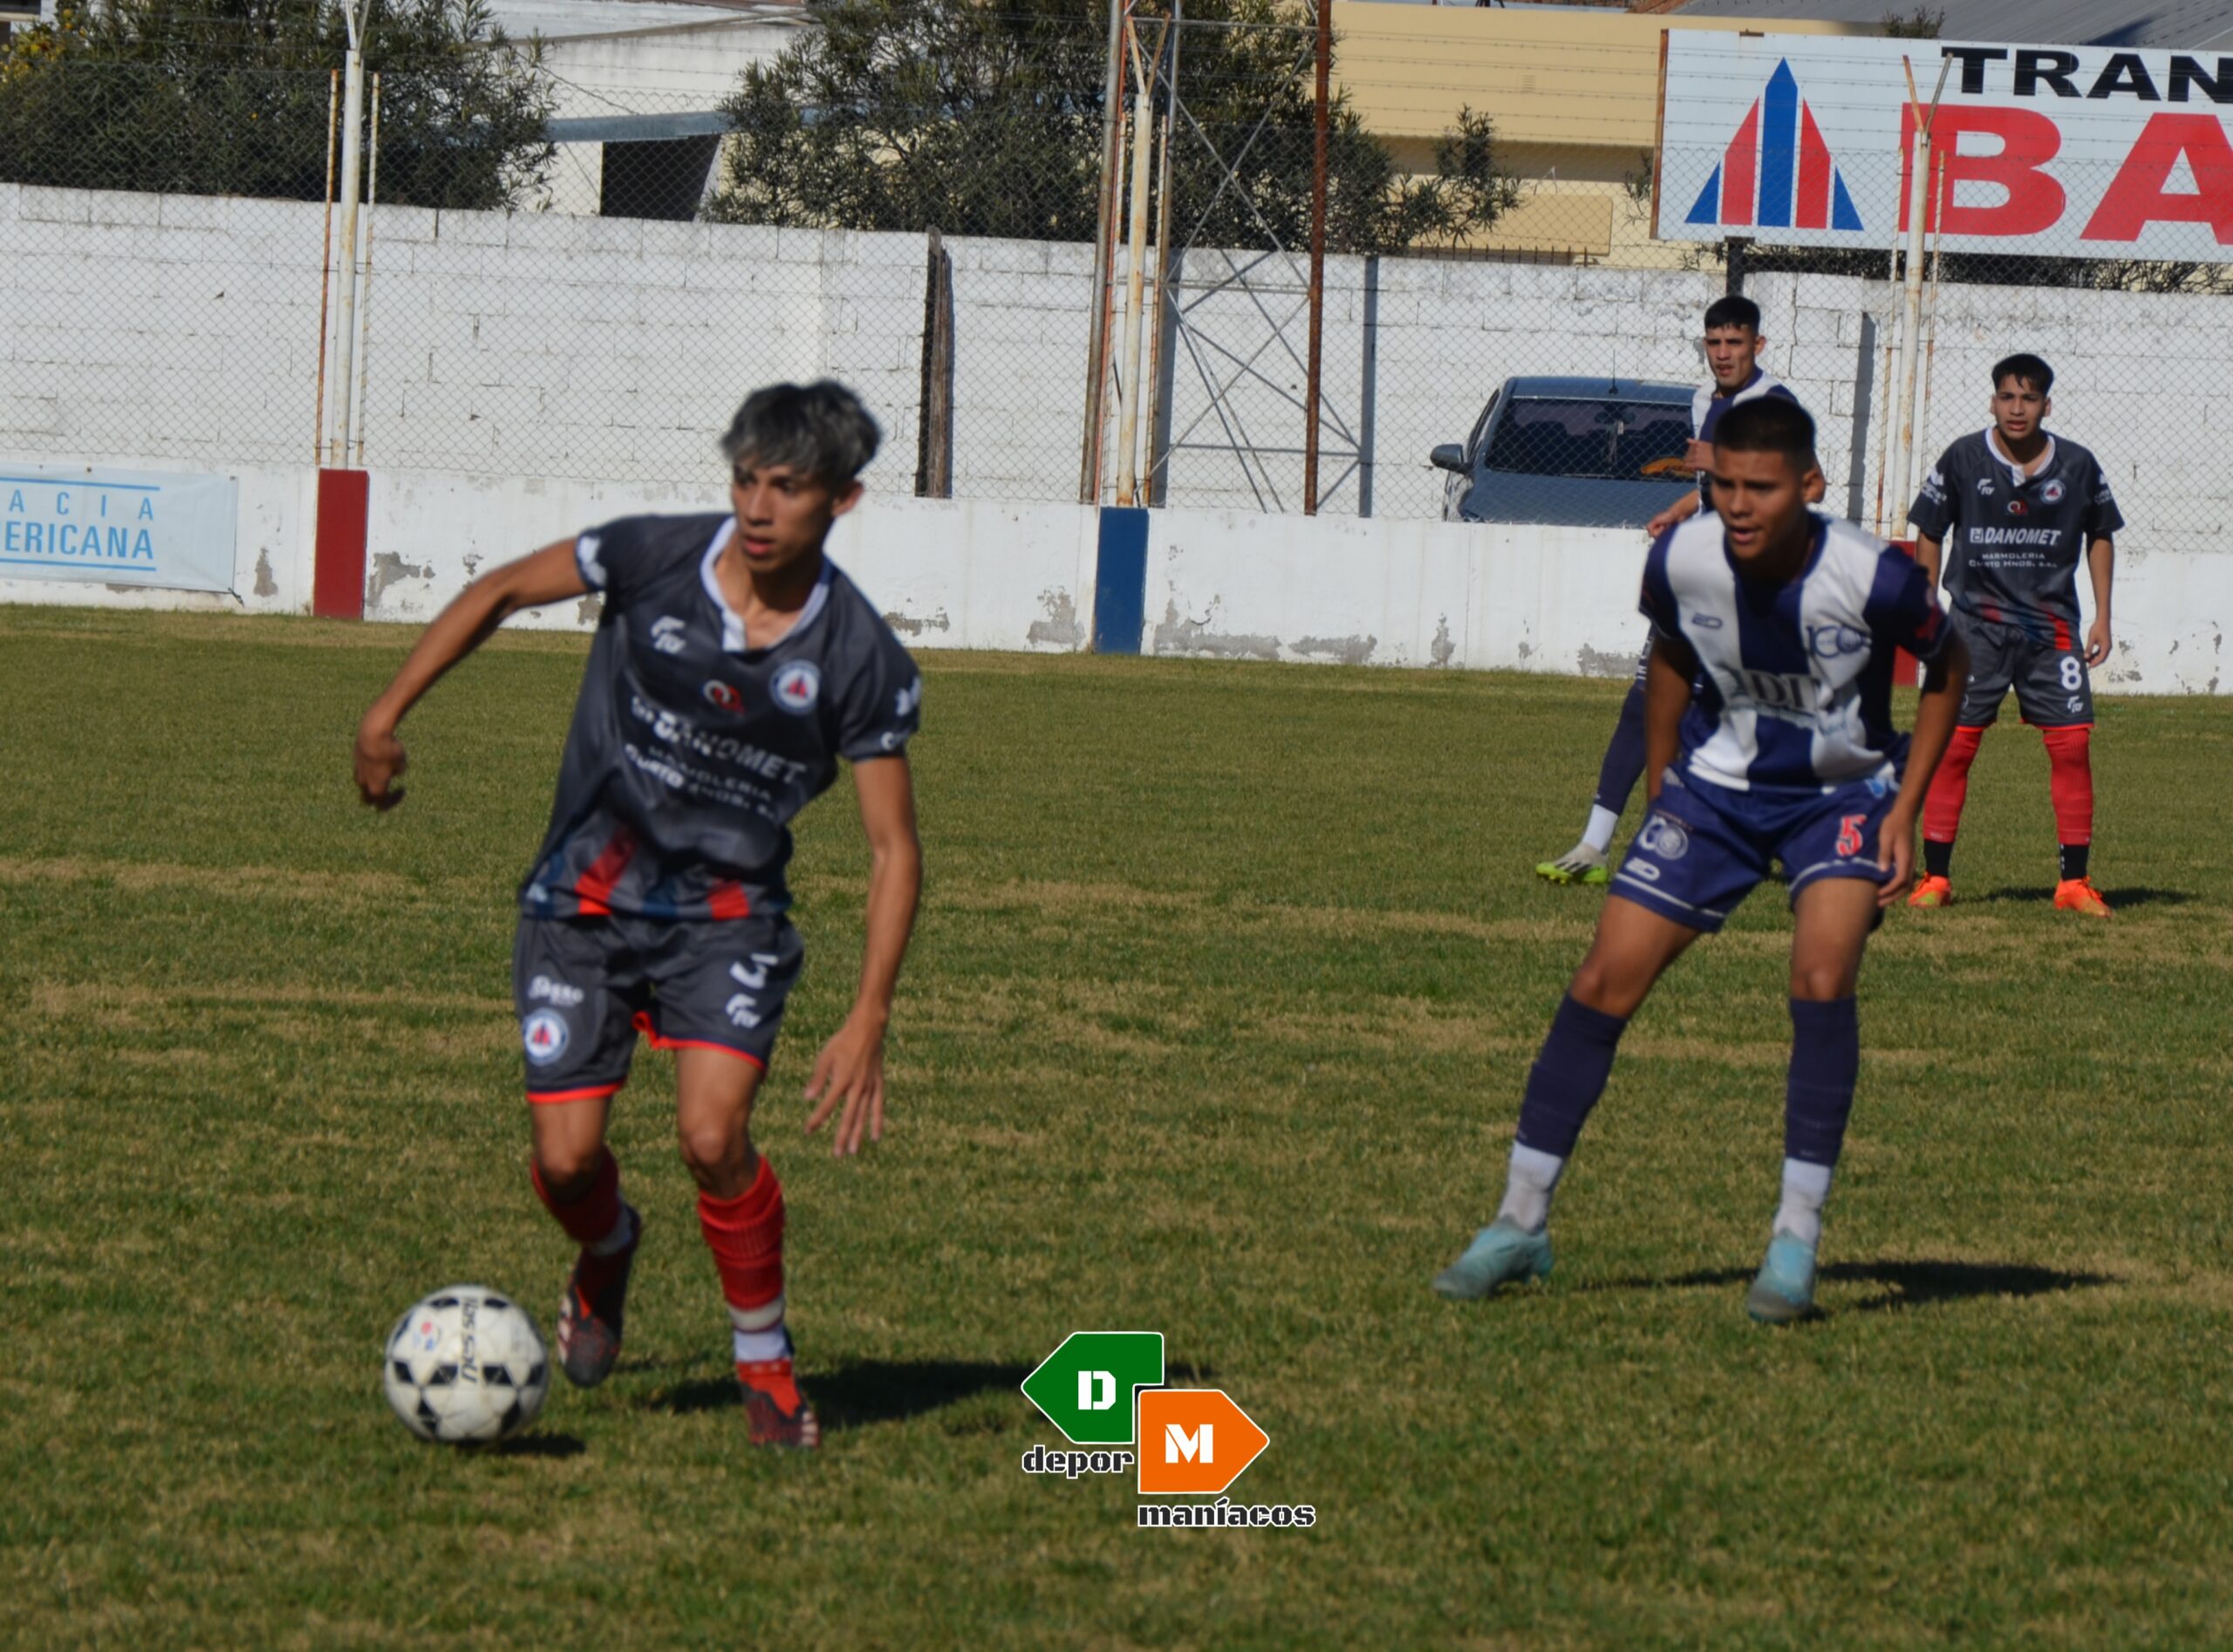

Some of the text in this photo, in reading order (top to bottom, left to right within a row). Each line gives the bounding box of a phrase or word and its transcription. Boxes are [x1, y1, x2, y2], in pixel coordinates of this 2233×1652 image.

[1942, 46, 2233, 104] TRAN
[1899, 102, 2233, 245] BA
[3, 521, 154, 560] ERICANA
[1984, 527, 2062, 546] DANOMET
[2059, 655, 2083, 692] 8
[1834, 814, 1868, 857] 5
